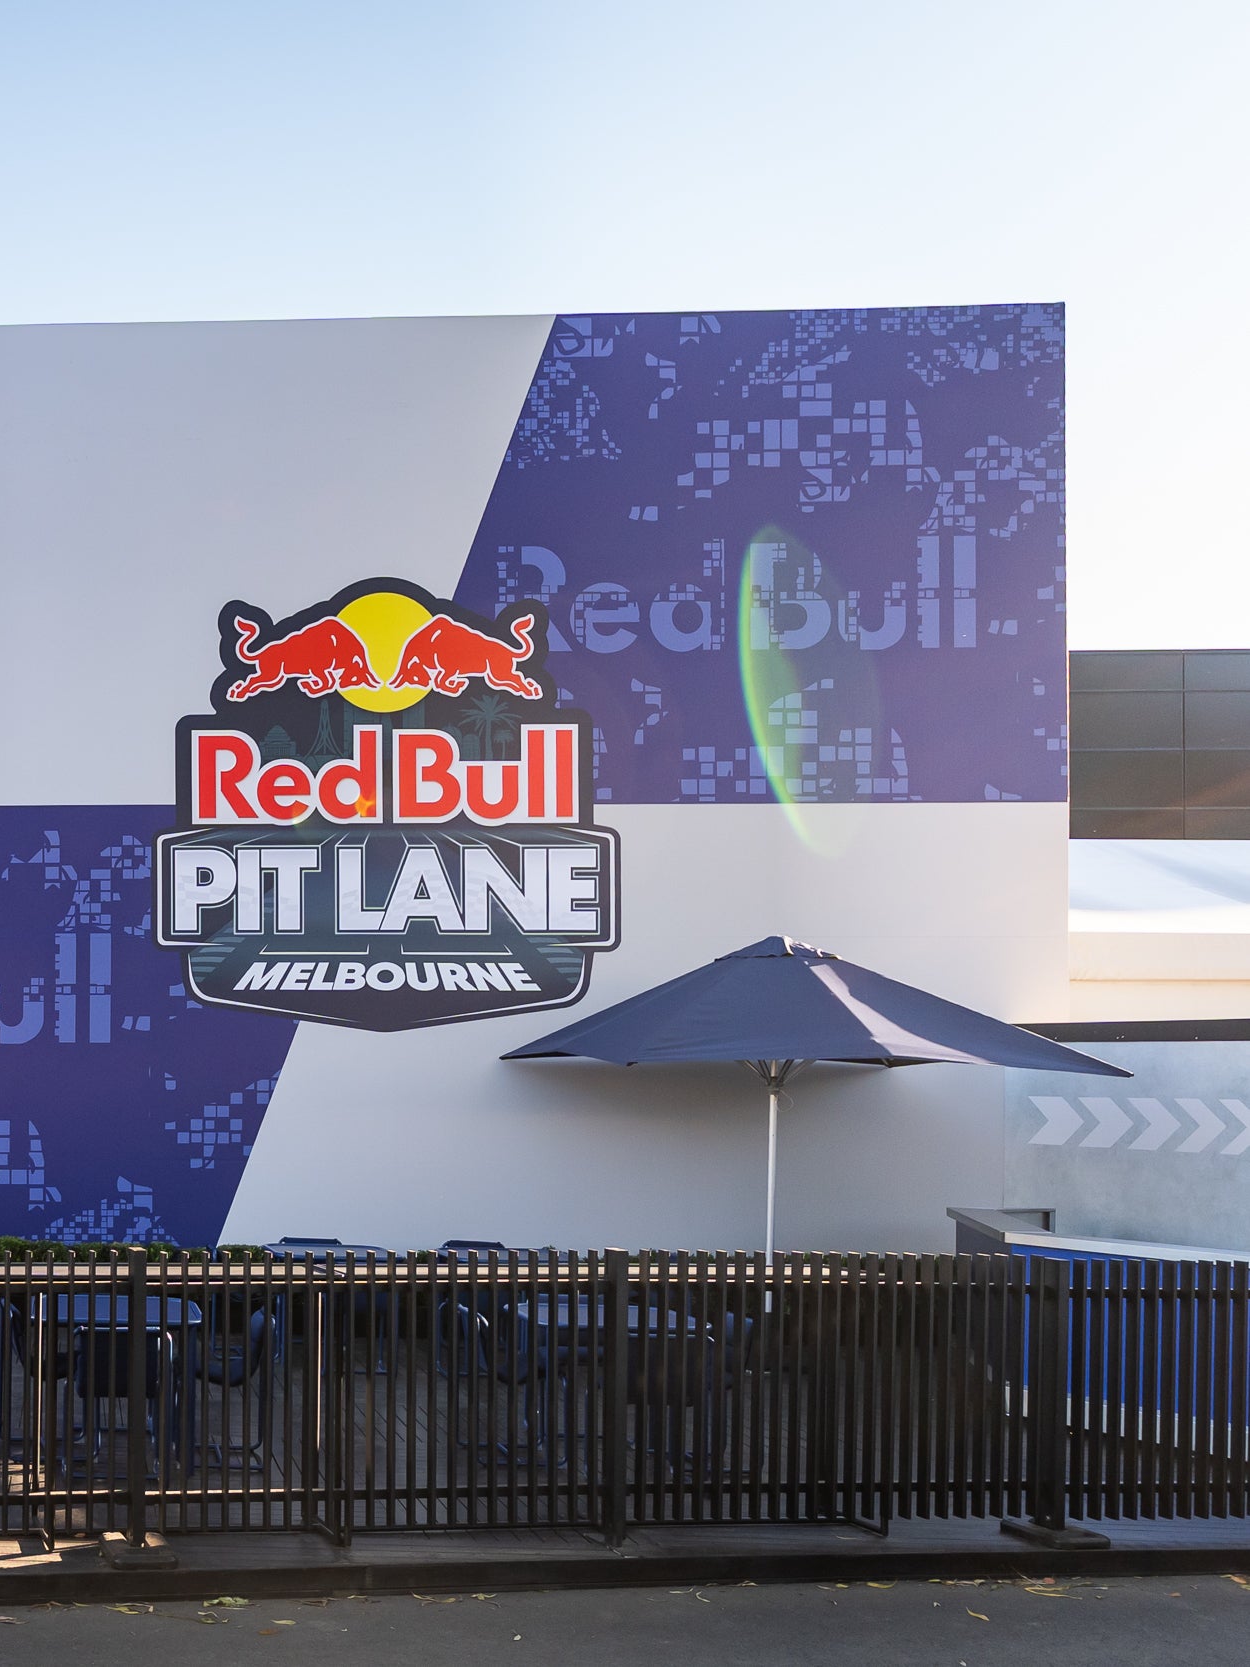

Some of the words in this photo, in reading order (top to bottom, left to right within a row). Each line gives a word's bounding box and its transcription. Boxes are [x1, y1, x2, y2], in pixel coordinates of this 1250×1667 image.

[494, 538, 725, 653] Red
[749, 536, 977, 651] Bull
[197, 730, 378, 820] Red
[398, 730, 574, 820] Bull
[172, 846, 320, 933] PIT
[337, 846, 600, 933] LANE
[232, 962, 542, 992] MELBOURNE
